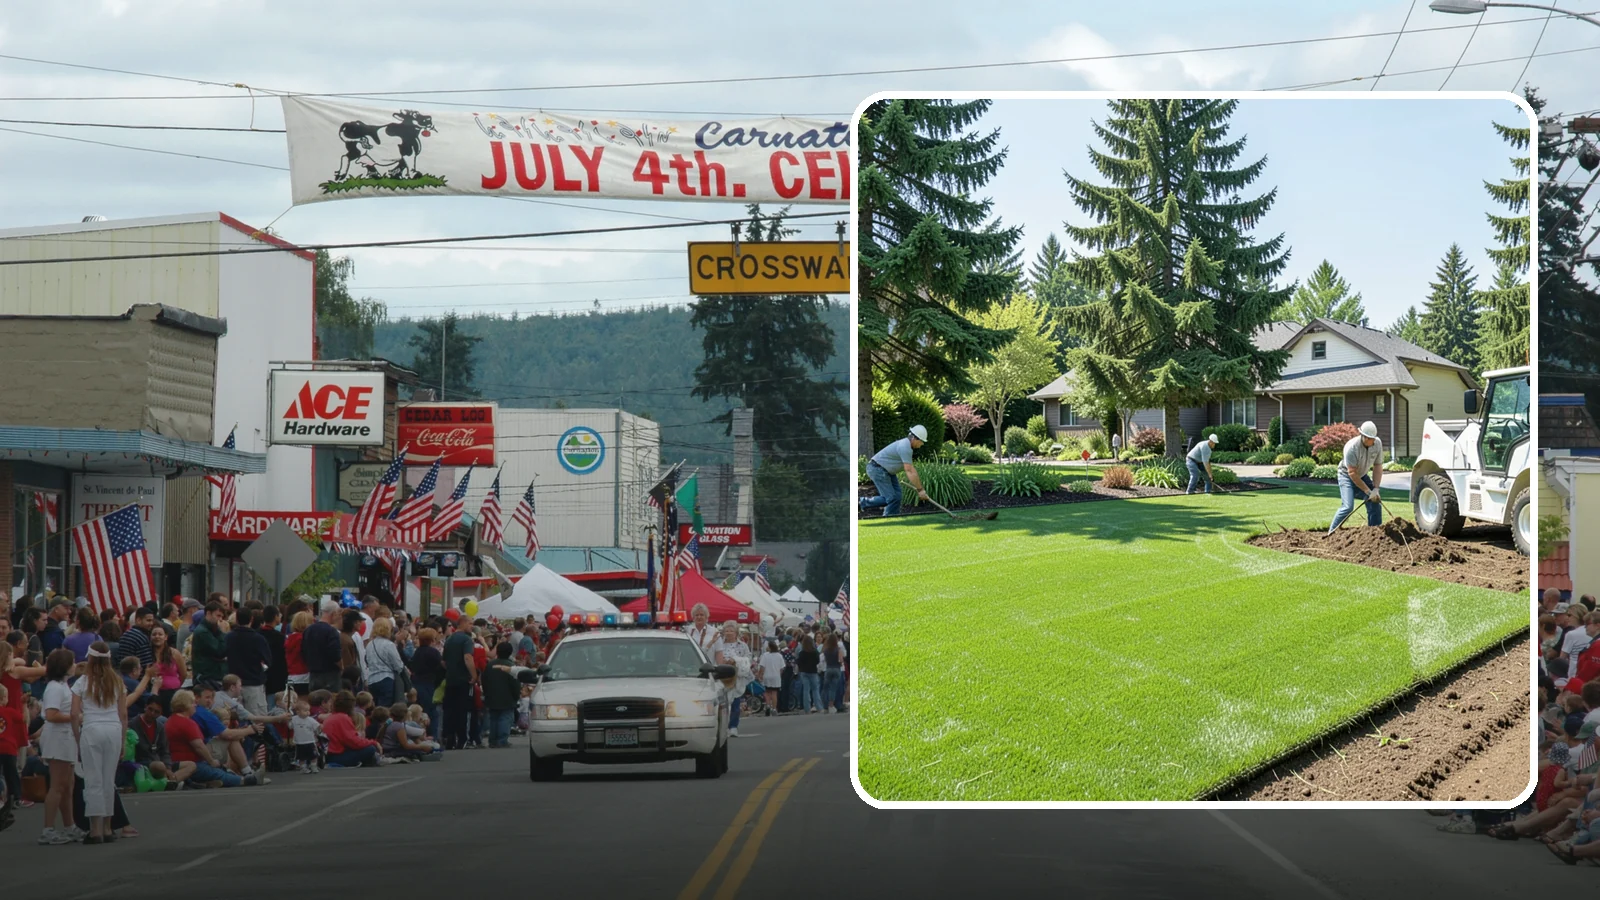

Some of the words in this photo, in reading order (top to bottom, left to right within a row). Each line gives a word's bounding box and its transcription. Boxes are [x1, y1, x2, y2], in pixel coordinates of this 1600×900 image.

[481, 140, 605, 193] JULY
[632, 150, 746, 198] 4th.
[697, 254, 850, 280] CROSSWA
[283, 380, 373, 420] ACE
[405, 409, 452, 422] CEDAR
[283, 421, 371, 436] Hardware
[416, 428, 477, 447] Coca-Cola
[353, 467, 387, 481] Simpl
[83, 484, 94, 494] St.
[96, 485, 124, 495] Vincent
[126, 486, 136, 495] de
[138, 486, 155, 495] Paul
[212, 516, 331, 536] HARDARE
[688, 526, 741, 535] CRNATION
[699, 535, 730, 543] GLASS
